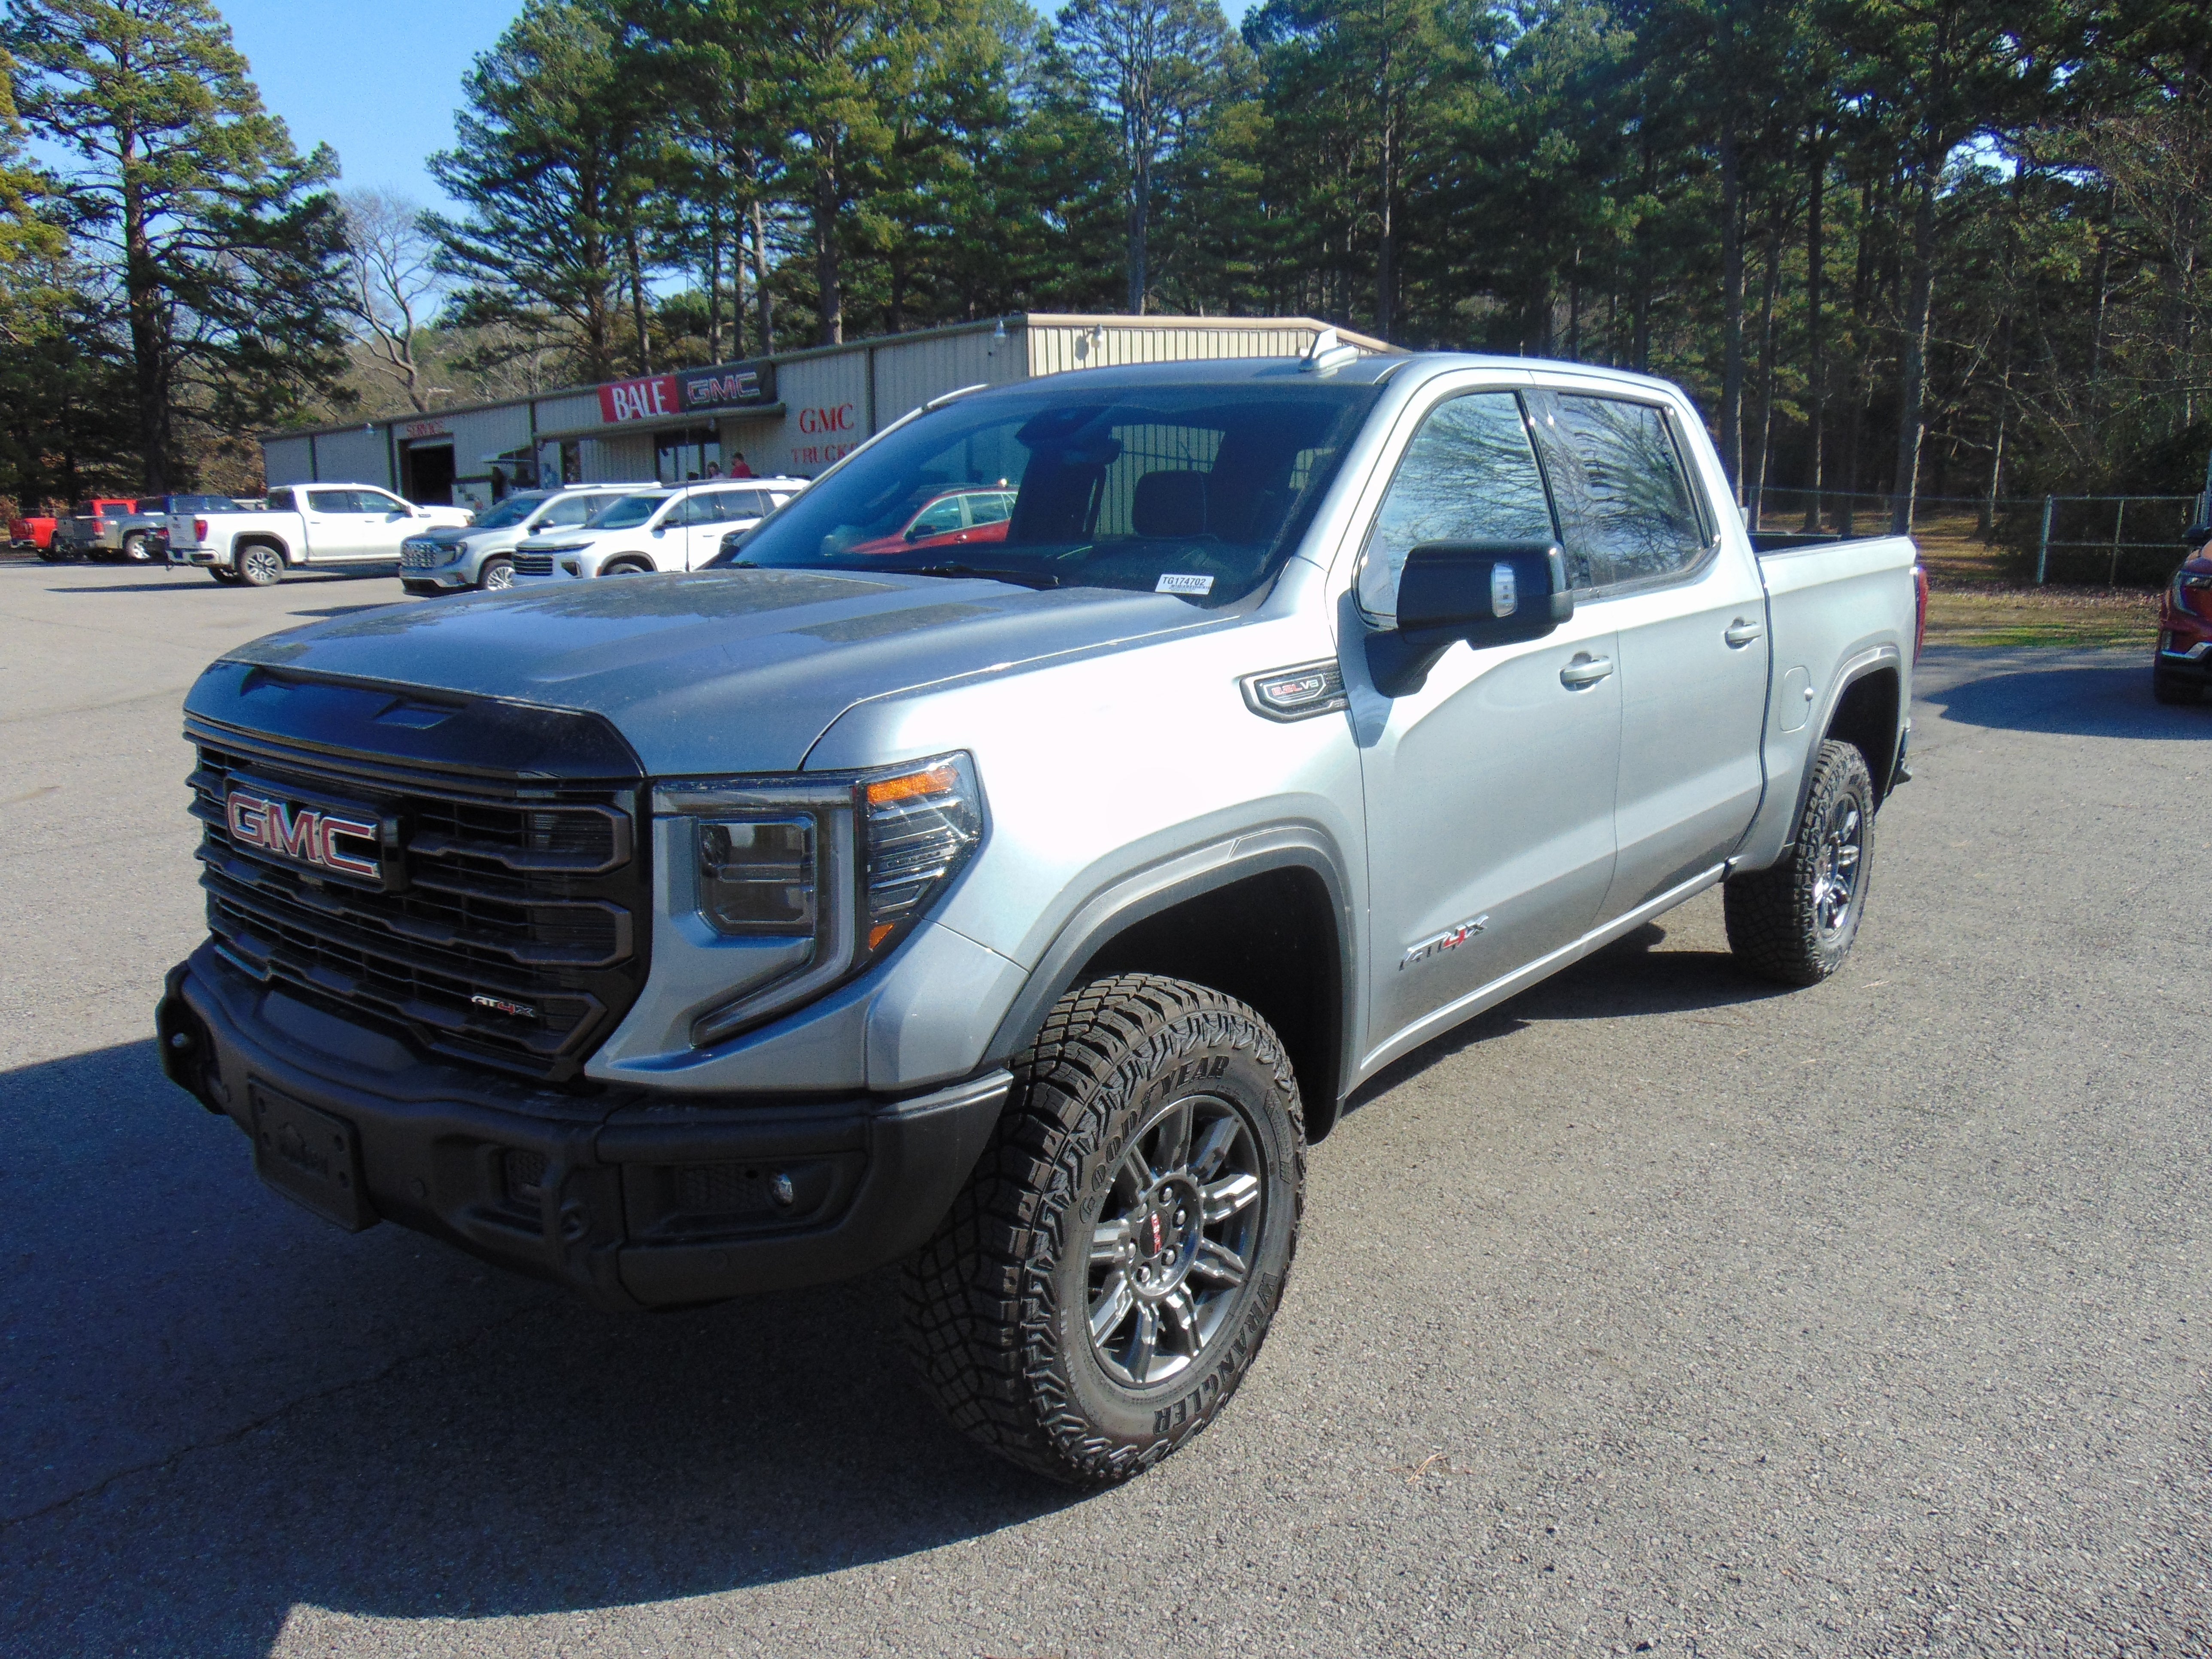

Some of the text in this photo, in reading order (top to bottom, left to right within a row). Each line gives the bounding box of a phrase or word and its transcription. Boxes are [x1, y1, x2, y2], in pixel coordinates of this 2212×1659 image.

[612, 380, 670, 422] BALE
[687, 371, 761, 404] GMC
[799, 402, 854, 434] GMC
[1162, 576, 1206, 586] TG174702
[228, 791, 381, 879] GMC
[1398, 915, 1489, 971] AT4X
[1153, 1272, 1278, 1436] WRANGLER
